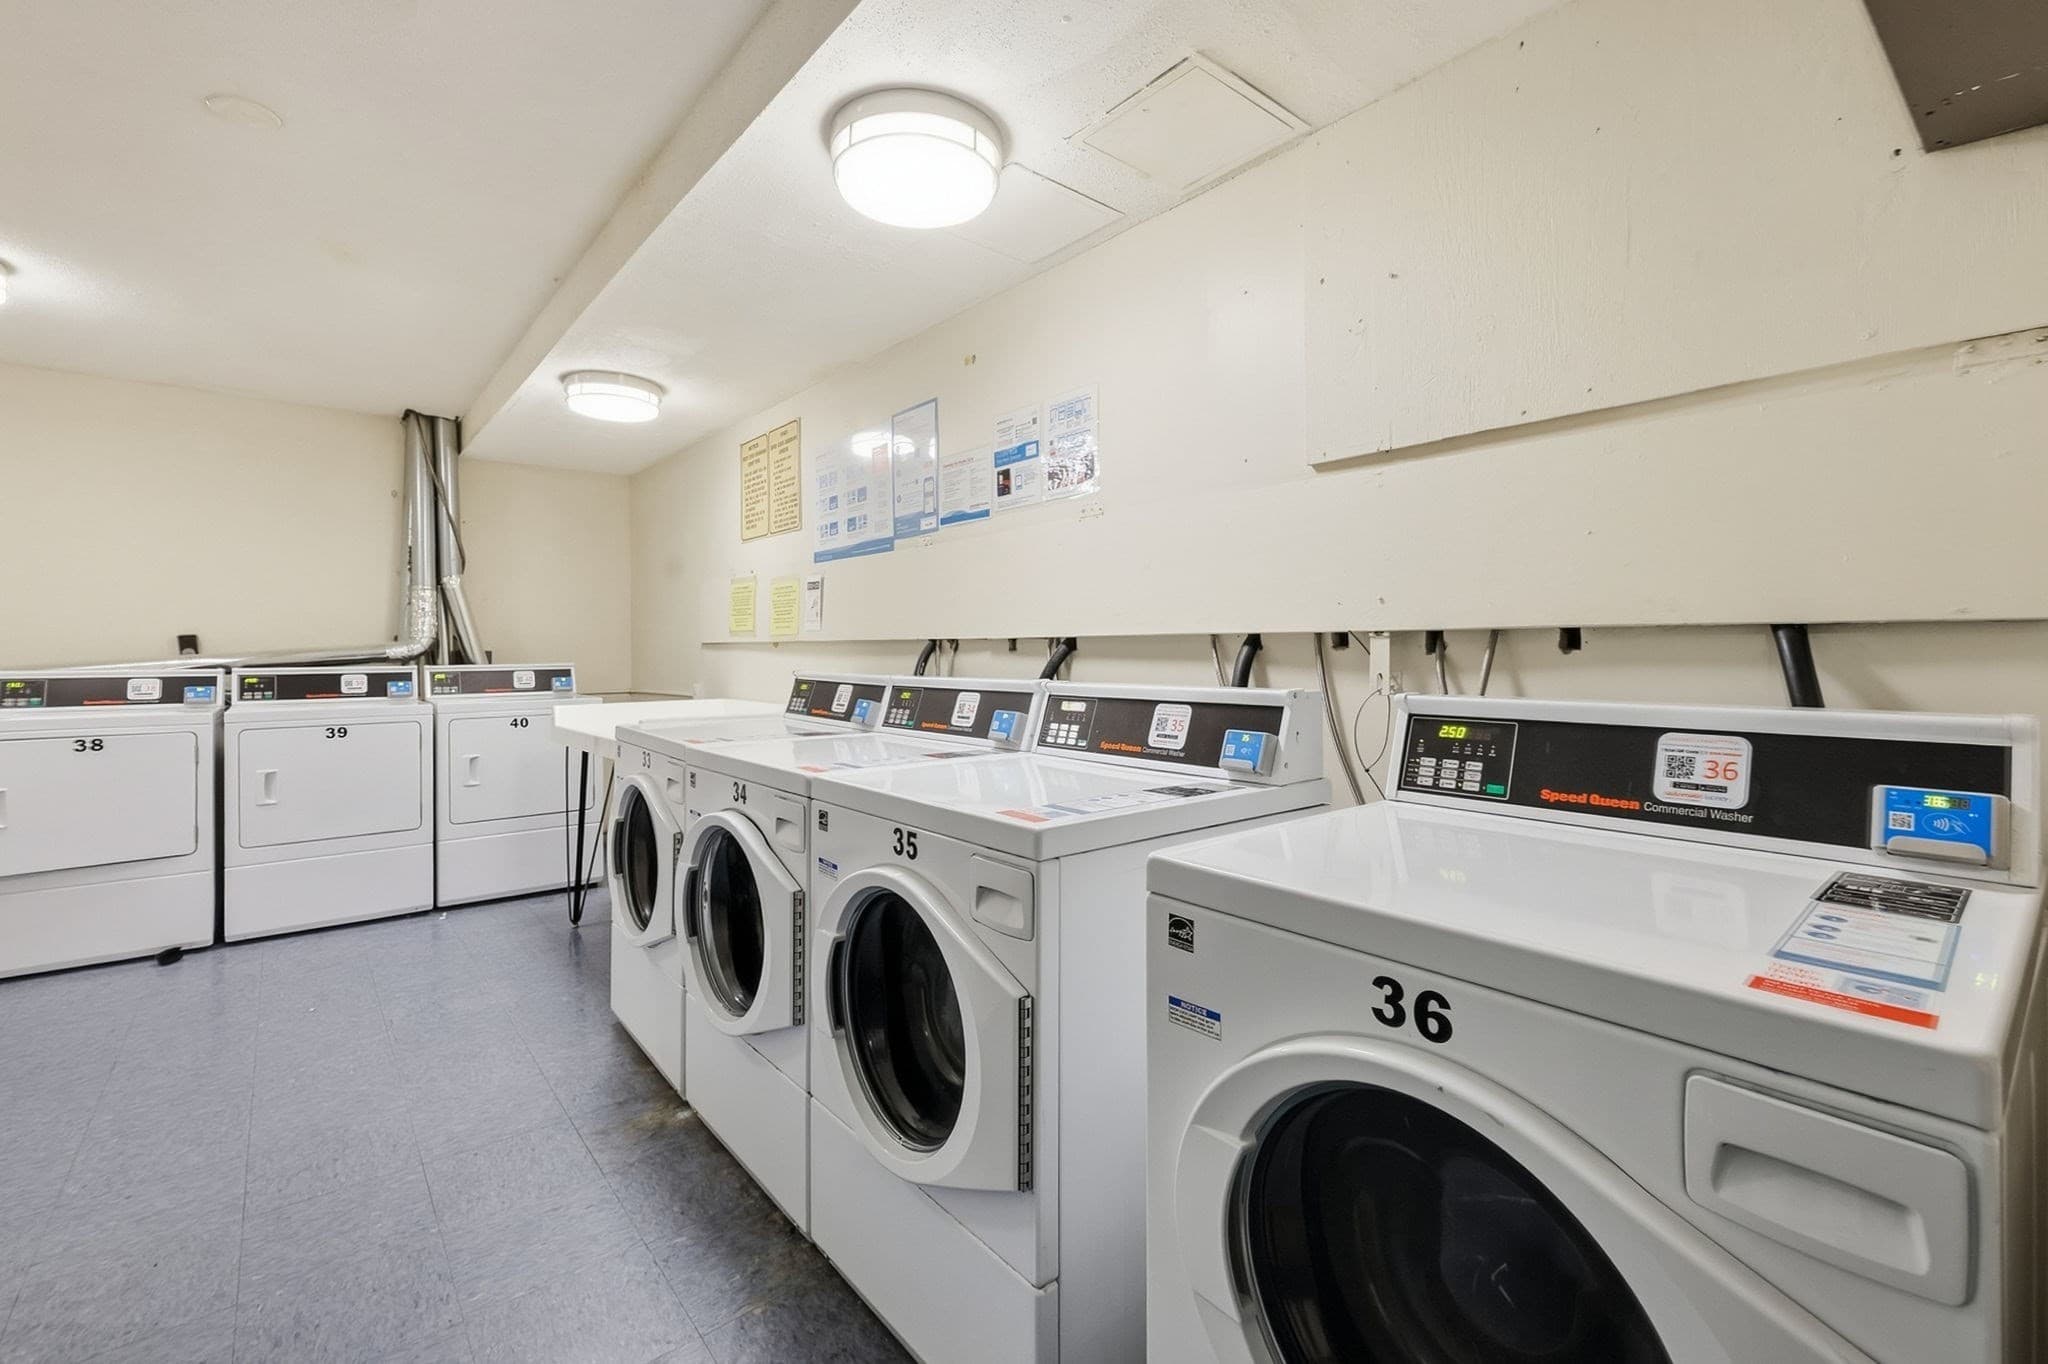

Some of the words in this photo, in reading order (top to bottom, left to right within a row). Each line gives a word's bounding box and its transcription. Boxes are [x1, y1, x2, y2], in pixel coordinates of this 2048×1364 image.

[510, 718, 529, 728] 40
[1170, 719, 1185, 732] 35
[325, 727, 348, 739] 39
[73, 738, 104, 752] 38
[642, 751, 651, 769] 33
[1703, 759, 1740, 781] 36
[732, 781, 747, 805] 34
[1539, 788, 1588, 805] Speed
[1589, 794, 1640, 810] Queen
[1643, 801, 1707, 818] Commercial
[1710, 809, 1754, 824] Washer
[892, 827, 918, 860] 35
[1180, 1001, 1208, 1017] NOTICE
[1371, 975, 1453, 1044] 36
